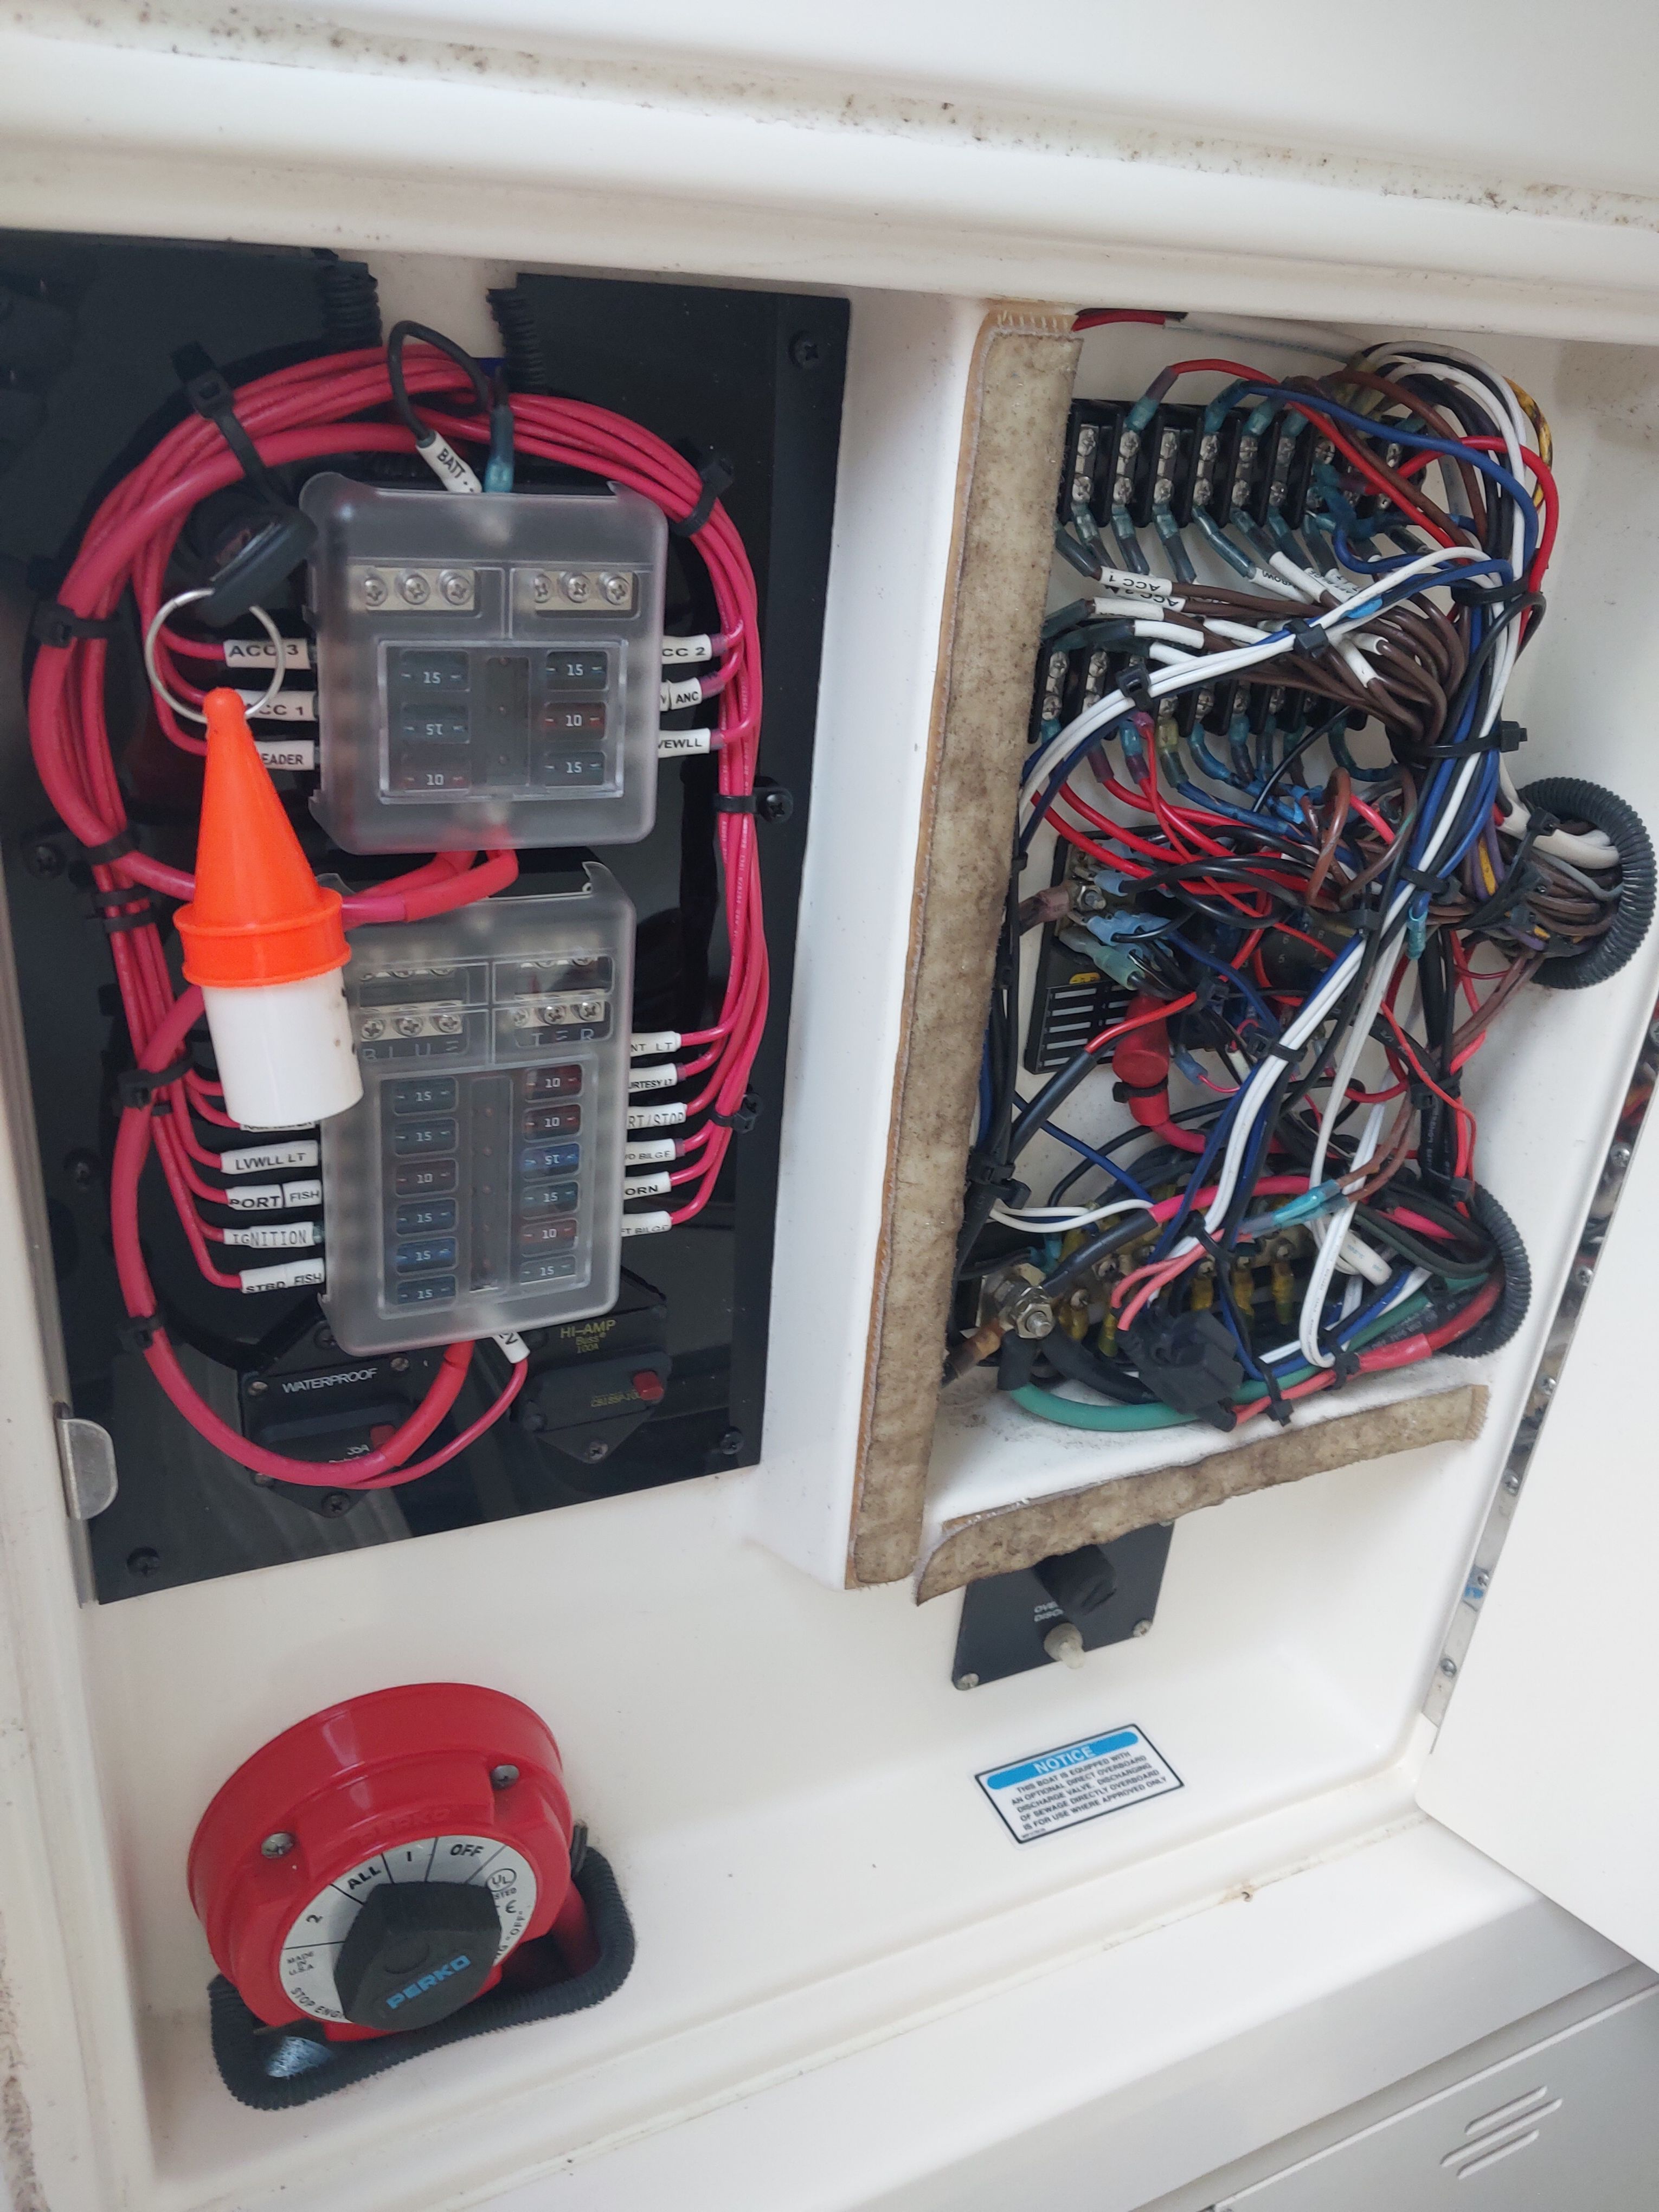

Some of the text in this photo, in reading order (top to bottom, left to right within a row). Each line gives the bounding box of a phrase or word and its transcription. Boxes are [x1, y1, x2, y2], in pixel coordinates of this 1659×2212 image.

[1123, 578, 1160, 591] ACC
[287, 644, 299, 656] 3
[662, 646, 706, 657] CC 2
[567, 664, 583, 676] 15
[423, 672, 442, 684] 15
[676, 691, 699, 704] ANC
[295, 706, 304, 716] 1
[565, 714, 582, 727] 10
[261, 753, 304, 765] EADER
[566, 762, 582, 774] 15
[426, 774, 445, 786] 10
[656, 1043, 673, 1051] LT
[545, 1078, 561, 1089] 10
[415, 1091, 432, 1102] 15
[545, 1117, 561, 1127] 10
[628, 1112, 683, 1128] RT/STOP
[415, 1131, 432, 1142] 15
[235, 1152, 306, 1171] LVWLL LT
[417, 1173, 433, 1184] 10
[625, 1185, 658, 1195] ORN
[230, 1189, 319, 1208] PORT FISH
[543, 1192, 558, 1203] 15
[417, 1213, 432, 1224] 15
[233, 1229, 307, 1246] IGNITION
[542, 1229, 557, 1239] 10
[415, 1251, 431, 1262] 15
[540, 1265, 555, 1276] 15
[294, 1272, 322, 1285] FISH
[417, 1289, 433, 1300] 15
[281, 1368, 378, 1393] WATERPROOF
[1033, 1745, 1098, 1775] NOTICE
[1017, 1779, 1037, 1793] THIS
[1037, 1774, 1059, 1789] BOAT
[1069, 1758, 1110, 1776] EQUIPPED
[1110, 1751, 1131, 1763] WITH
[1011, 1754, 1147, 1806] AN OPTIONAL DIRECT OVERBOARD
[1017, 1791, 1066, 1813] DISCHARGE
[1096, 1762, 1153, 1784] DISCHARGING
[1020, 1769, 1160, 1822] OF SEWAGE DIRECTLY OVERBOARD
[1023, 1776, 1168, 1831] IS FOR USE WHERE APPROVED ONLY
[451, 1844, 484, 1856] OFF
[345, 1867, 382, 1891] ALL
[307, 1914, 323, 1924] 2
[385, 1954, 471, 2009] PERKO
[291, 1986, 316, 2007] STOP
